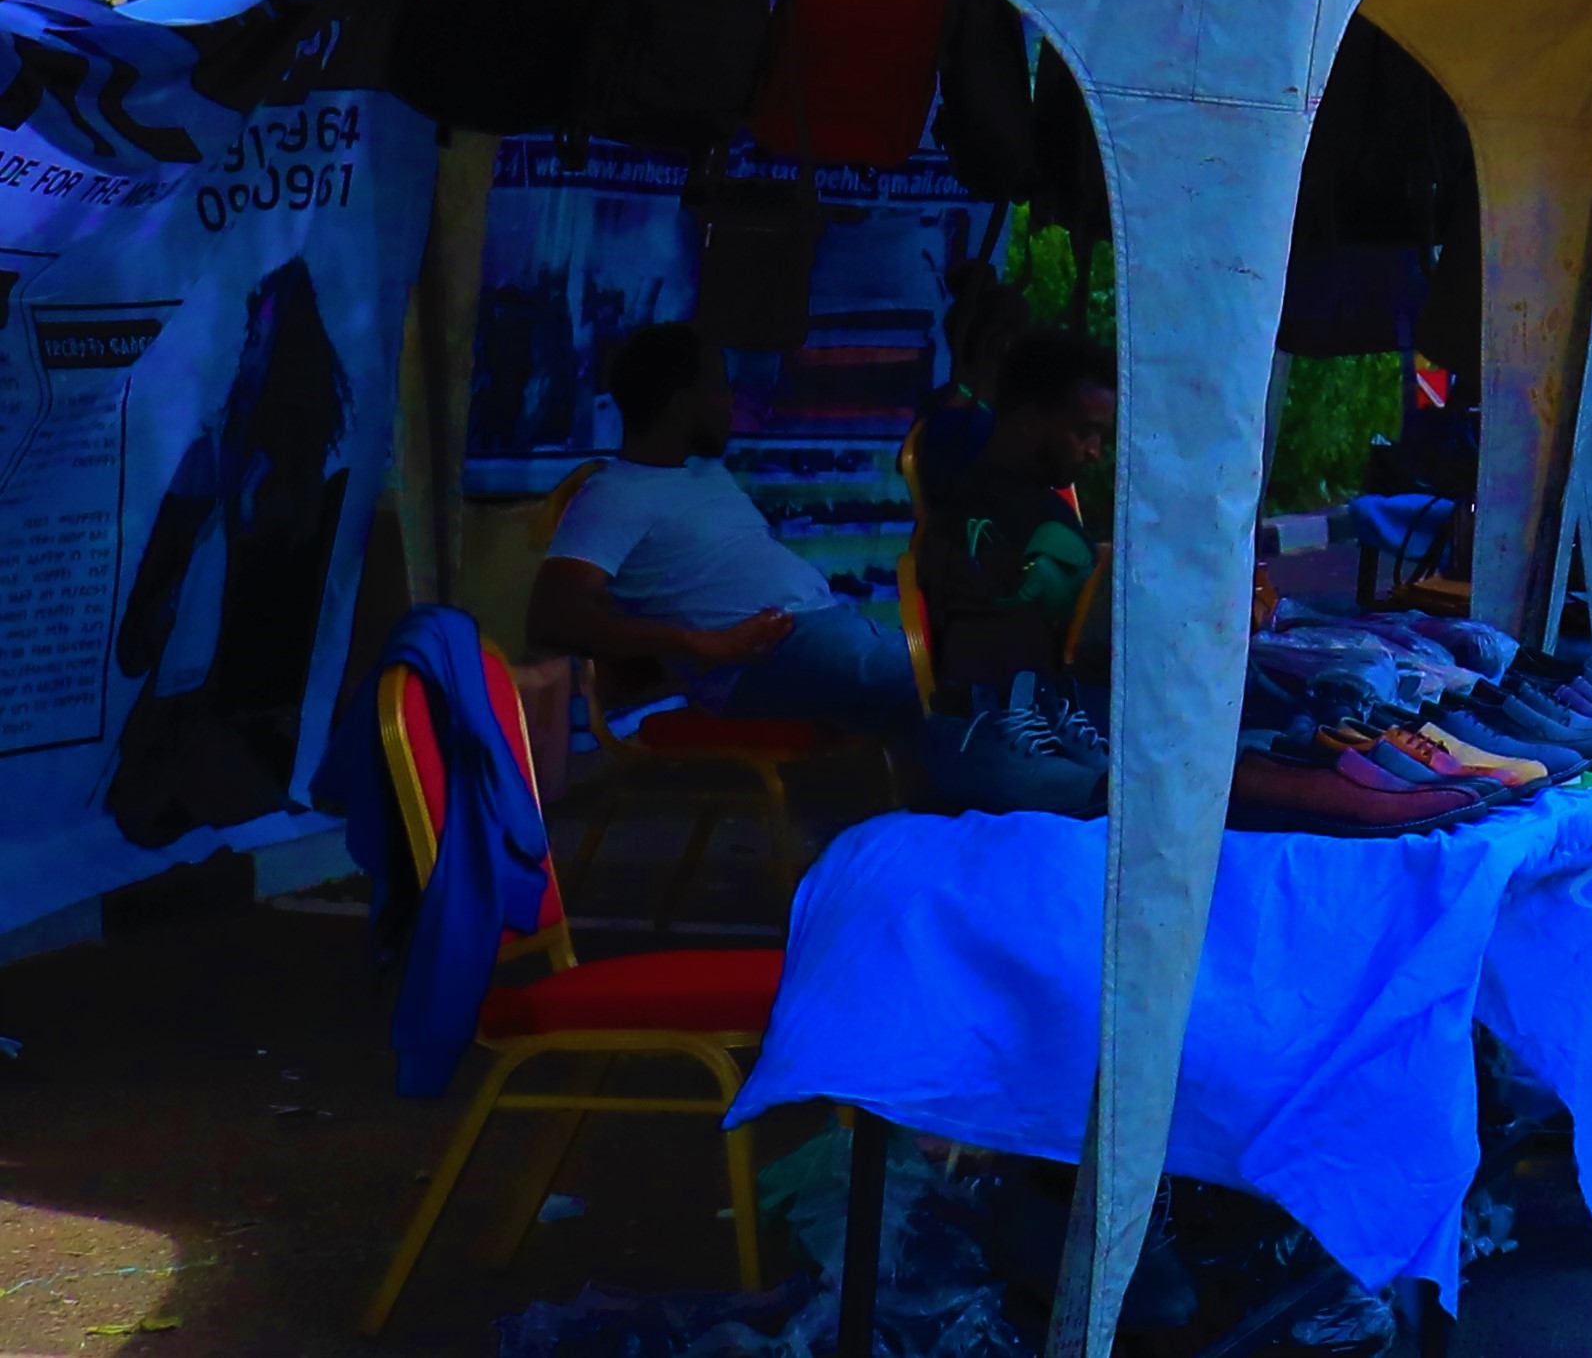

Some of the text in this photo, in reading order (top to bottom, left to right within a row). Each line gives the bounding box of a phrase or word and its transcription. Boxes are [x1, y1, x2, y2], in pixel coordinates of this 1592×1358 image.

[0, 151, 40, 187] DE
[30, 165, 84, 198] FOR
[80, 175, 130, 205] THE
